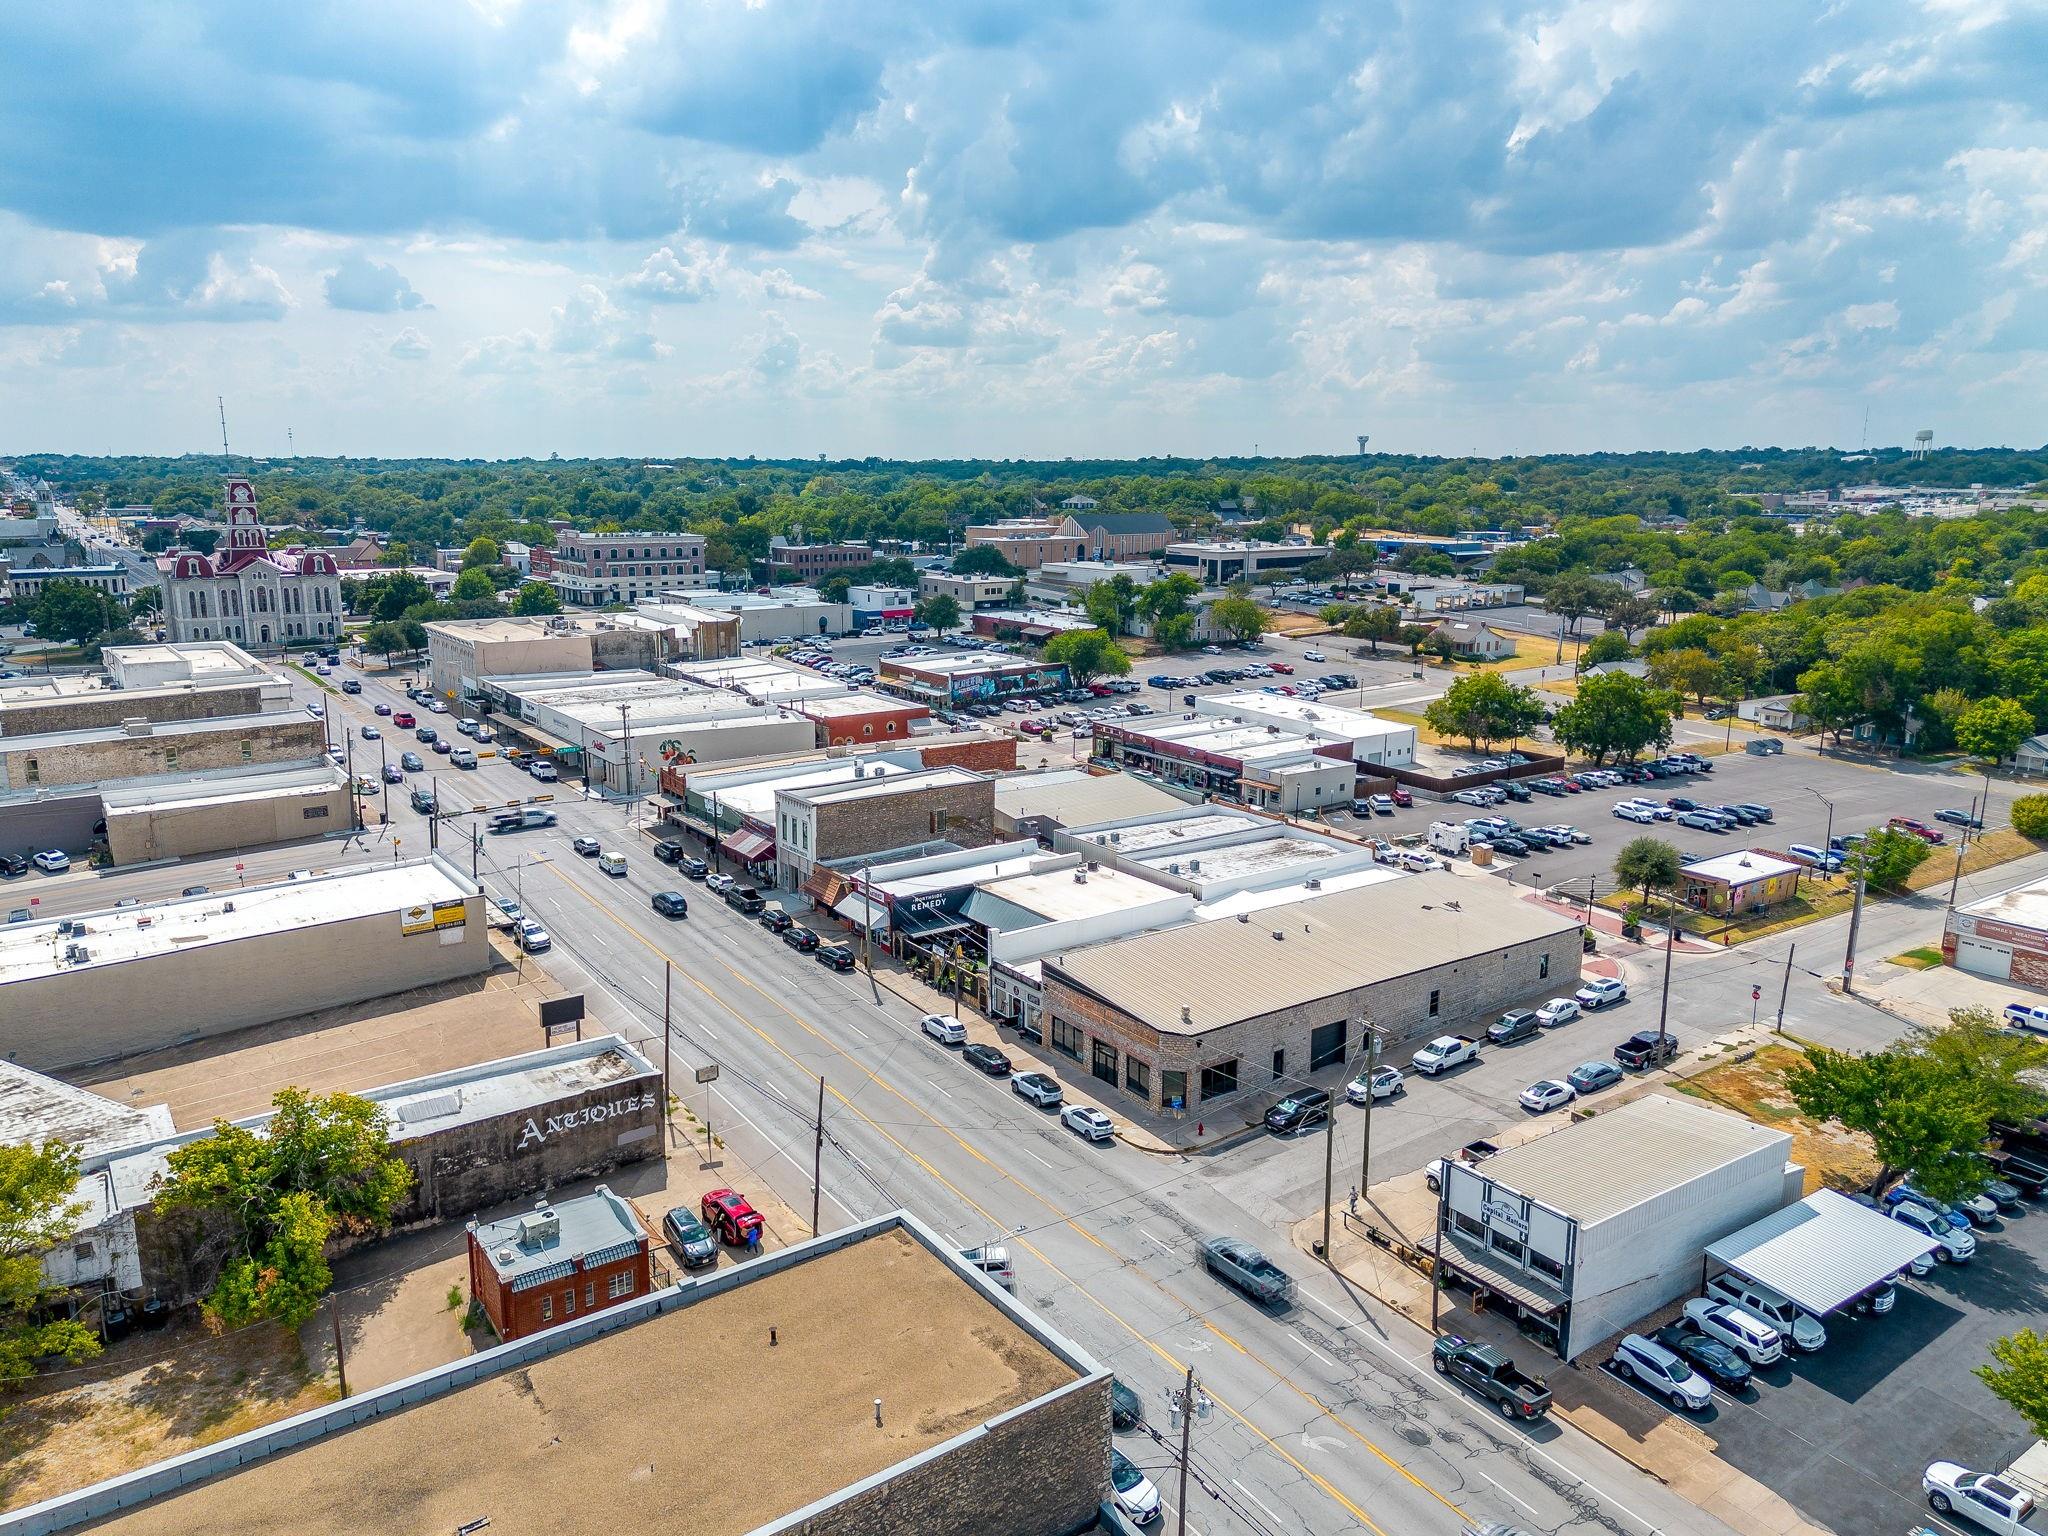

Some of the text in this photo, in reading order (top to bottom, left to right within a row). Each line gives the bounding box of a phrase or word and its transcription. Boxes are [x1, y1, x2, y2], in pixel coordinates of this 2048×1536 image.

[911, 898, 947, 912] REMEDY
[914, 893, 943, 903] NORTHSIDE
[1482, 1203, 1528, 1231] Capital Hatters
